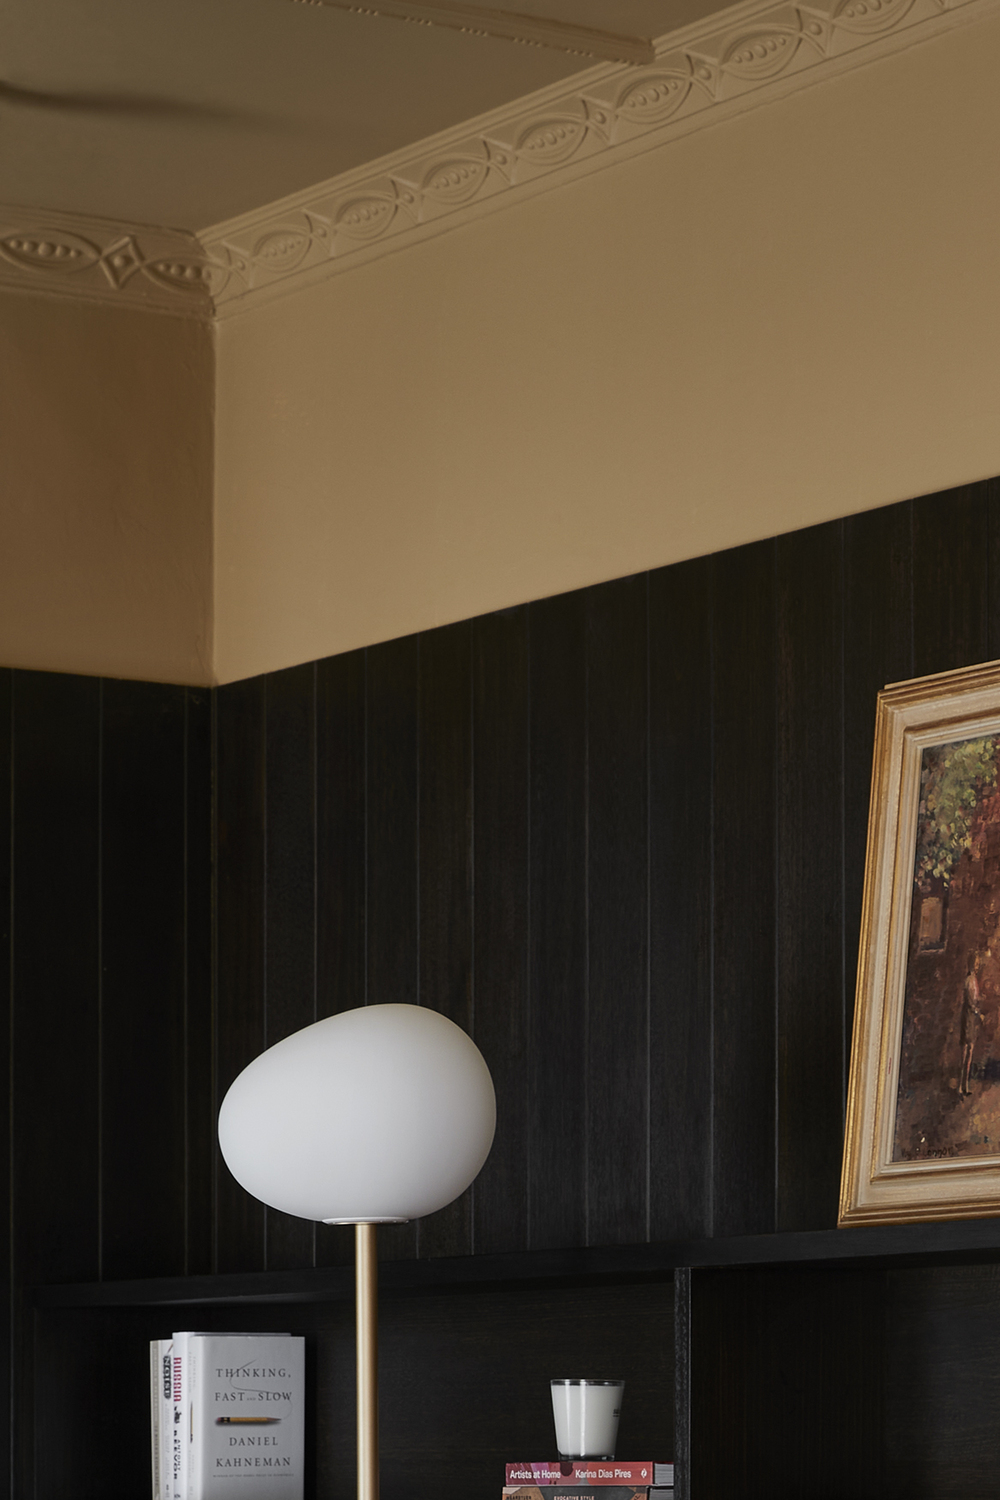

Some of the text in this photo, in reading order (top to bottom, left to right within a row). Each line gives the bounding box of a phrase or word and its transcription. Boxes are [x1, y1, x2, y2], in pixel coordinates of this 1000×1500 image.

[215, 1368, 292, 1378] THINKING,
[215, 1392, 245, 1401] FAST
[258, 1392, 292, 1401] SLOW
[229, 1437, 278, 1446] DANIEL
[216, 1457, 291, 1467] KAHNEMAN
[510, 1469, 561, 1479] Artists at Home
[575, 1469, 632, 1478] Karina Dias Pires
